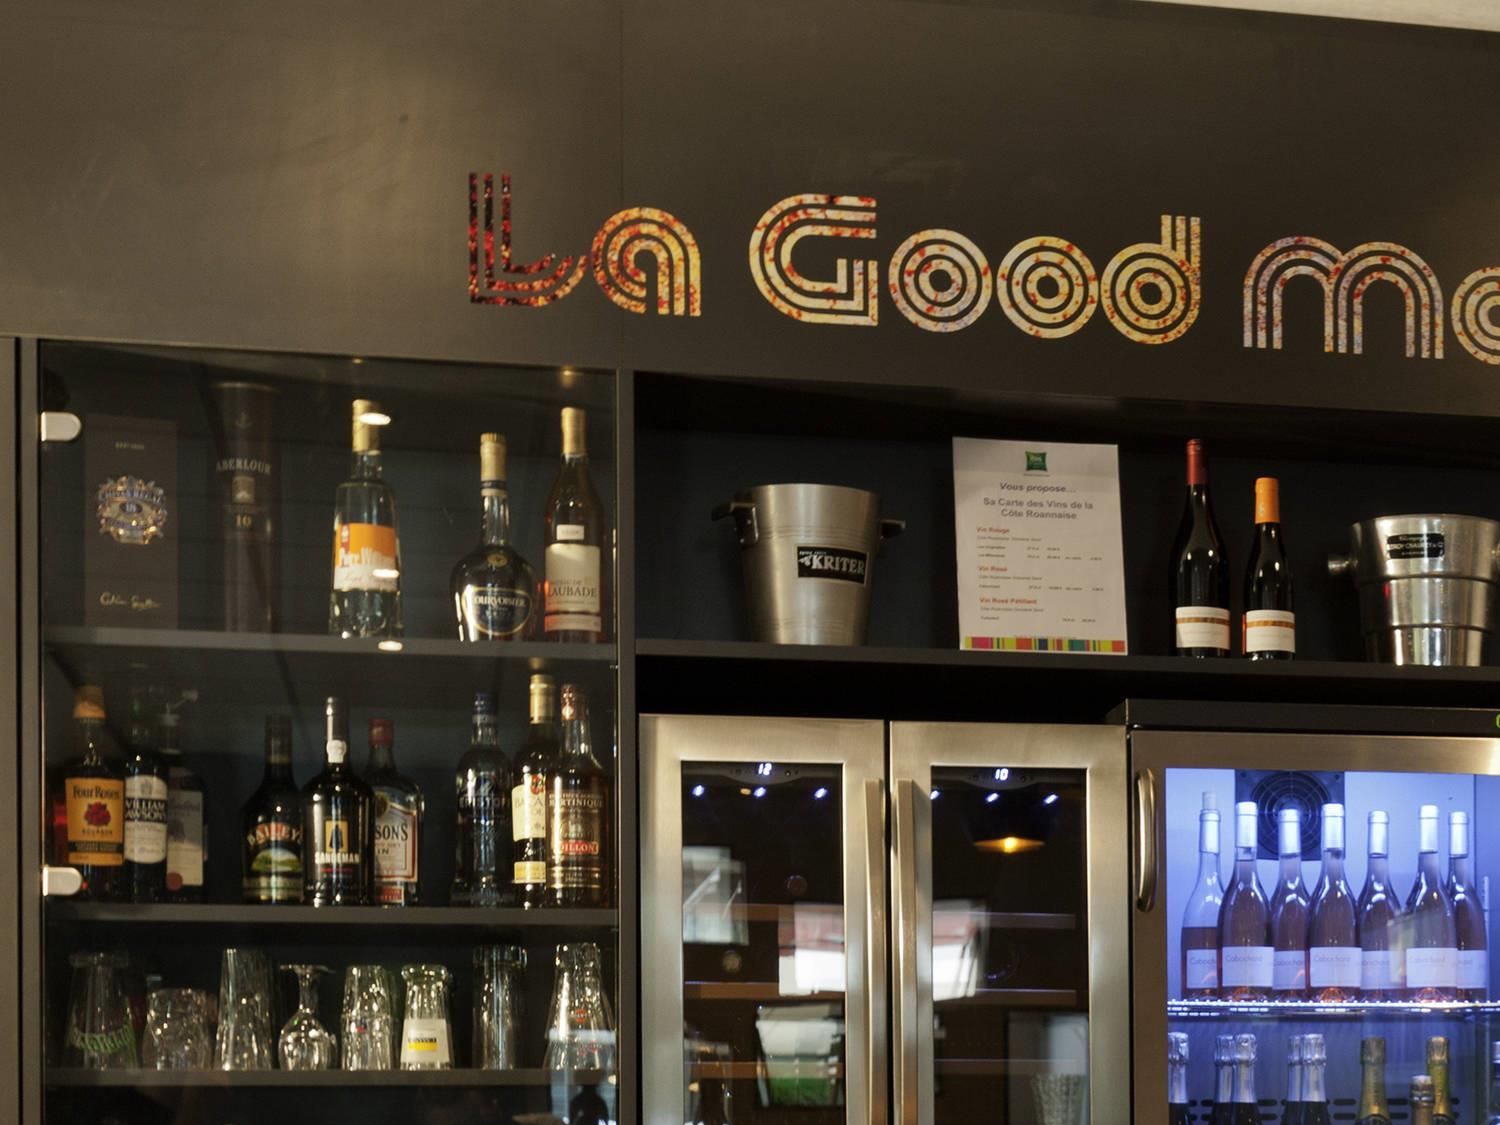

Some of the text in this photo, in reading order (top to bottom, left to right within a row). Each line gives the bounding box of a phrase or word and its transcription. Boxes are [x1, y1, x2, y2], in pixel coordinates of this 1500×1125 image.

[467, 171, 703, 318] La
[748, 192, 1203, 346] Good
[216, 458, 272, 475] ABERLOUR
[1000, 482, 1024, 491] Vous
[984, 497, 1094, 510] Sa Carte des Vins de la
[235, 514, 251, 529] 10
[1026, 509, 1077, 520] Roannaise
[811, 554, 865, 575] KRITER
[995, 768, 1008, 781] 10
[73, 785, 121, 799] Four Roses
[549, 799, 603, 808] MRTINIQUE
[314, 851, 360, 865] SANDEMAN
